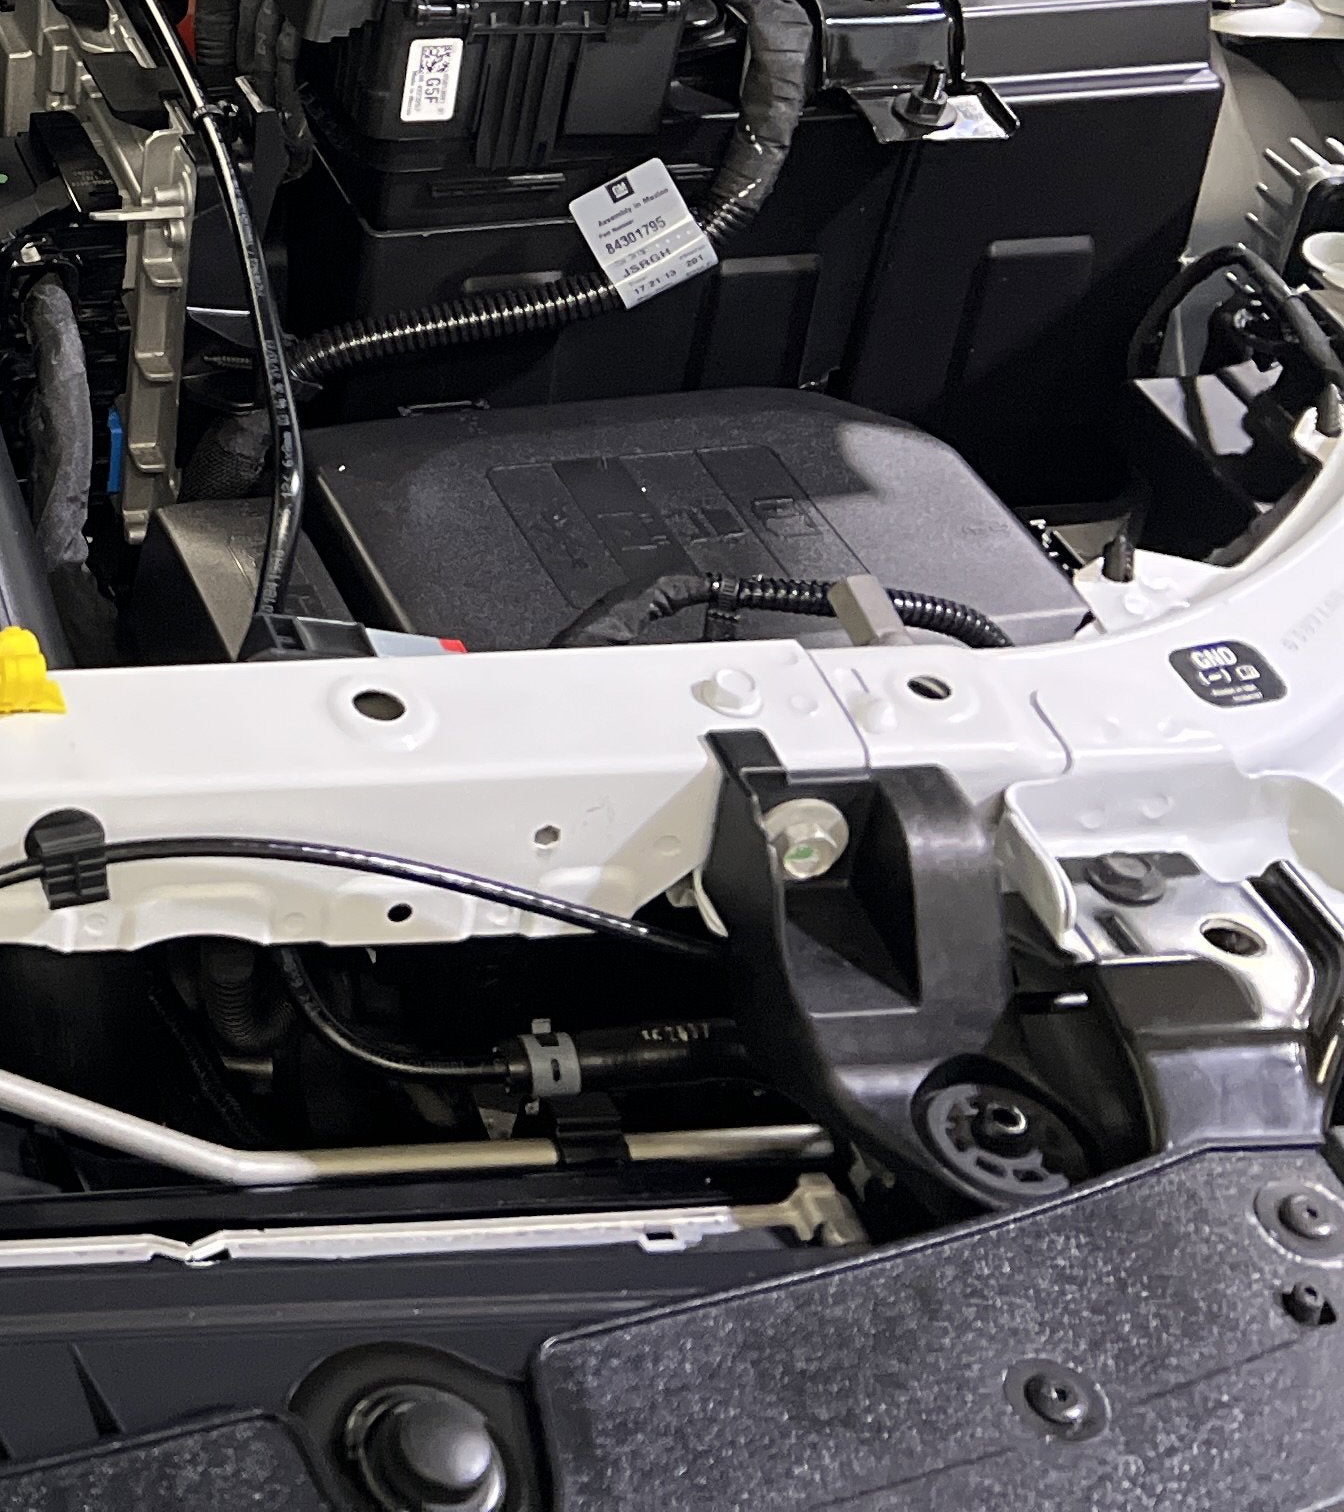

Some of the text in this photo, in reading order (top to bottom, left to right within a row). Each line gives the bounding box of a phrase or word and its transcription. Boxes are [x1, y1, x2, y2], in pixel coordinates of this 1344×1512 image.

[424, 77, 441, 103] G5F
[605, 215, 666, 255] 84301795
[1191, 646, 1238, 670] GND
